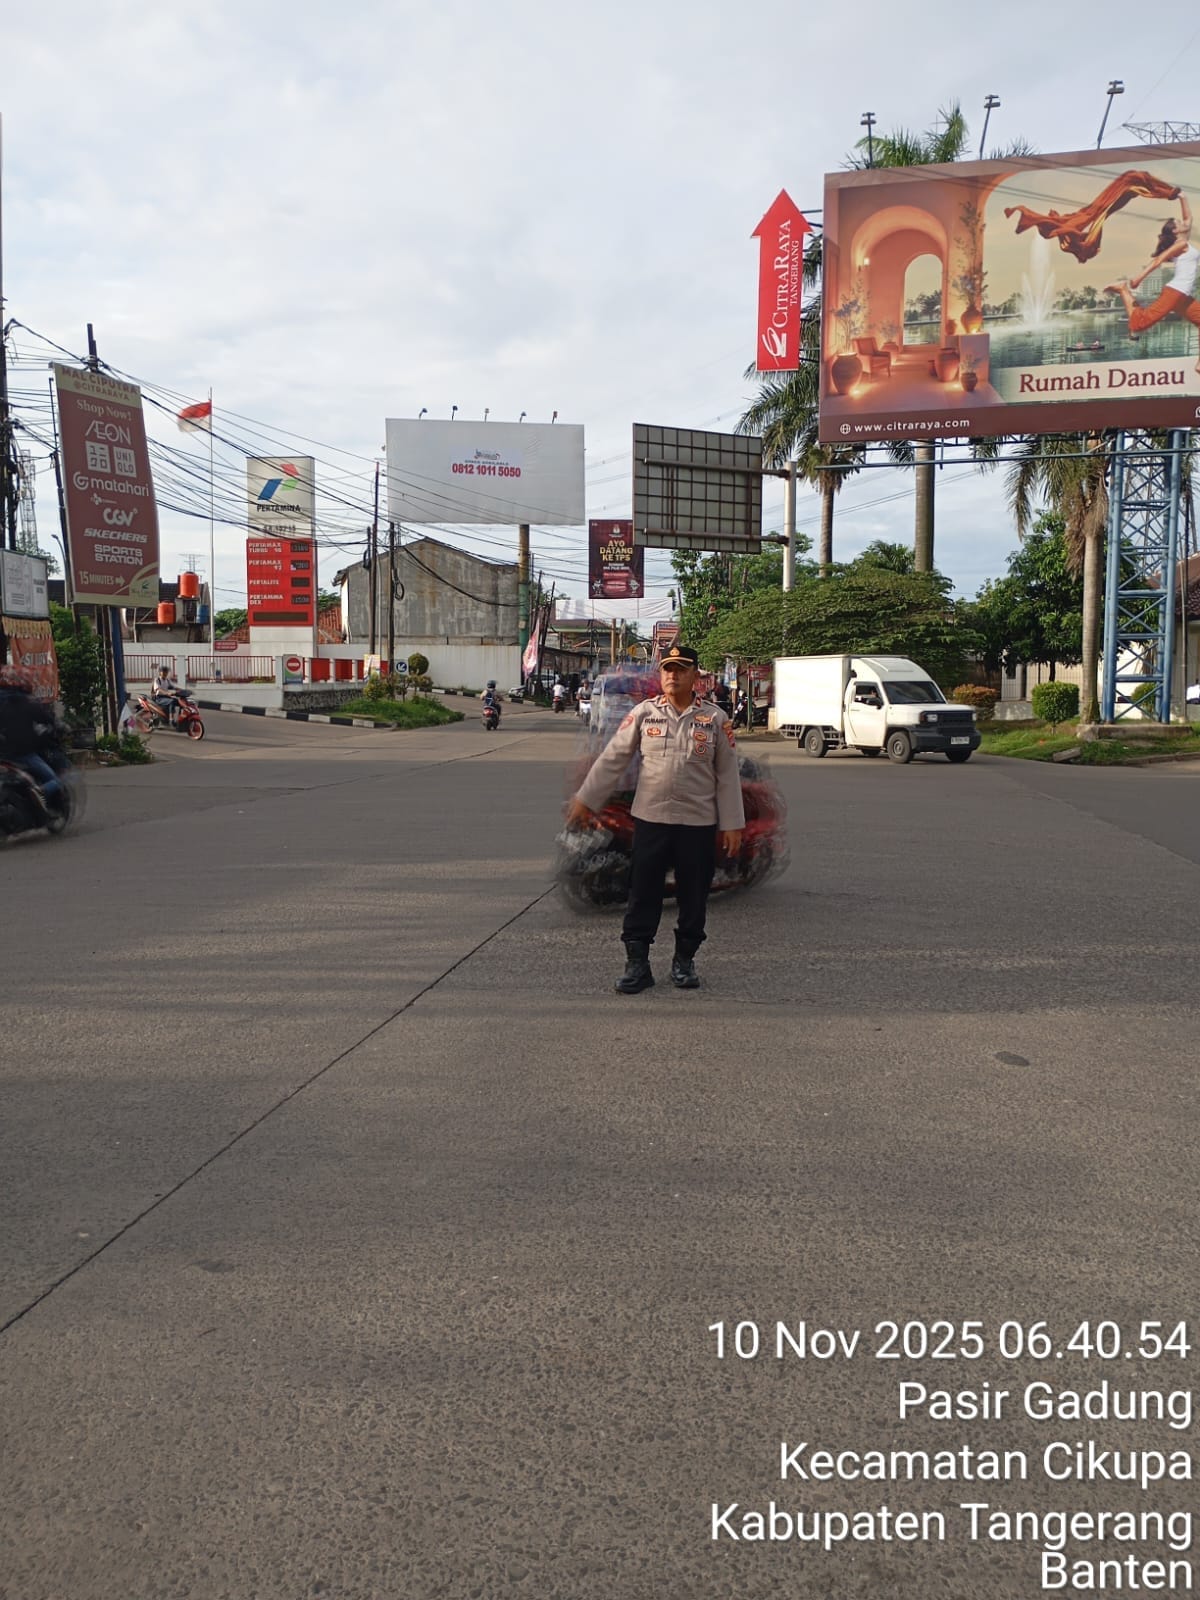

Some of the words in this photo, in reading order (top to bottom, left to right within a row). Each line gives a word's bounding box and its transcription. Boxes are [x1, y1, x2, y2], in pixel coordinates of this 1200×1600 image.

[789, 240, 799, 307] TANGERANG
[61, 367, 87, 381] MAL
[89, 374, 139, 394] CIPUTRA
[1019, 370, 1101, 394] Rumah
[1107, 366, 1186, 388] Danau
[76, 399, 104, 417] Shop
[105, 406, 132, 421] Now!
[854, 417, 971, 433] www.citraraya.com
[116, 450, 132, 463] UNI
[117, 462, 134, 475] QLO
[452, 463, 474, 475] 0812
[476, 464, 496, 476] 1011
[498, 466, 521, 477] 5050
[90, 478, 150, 497] matahari
[256, 504, 301, 513] PERTAMINA
[103, 507, 134, 527] CGV
[83, 528, 148, 543] SKECHERS
[607, 539, 625, 547] AYO
[94, 544, 143, 557] SPORTS
[599, 546, 633, 555] DATANG
[95, 553, 143, 566] STATION
[602, 554, 614, 562] KE
[615, 554, 631, 562] TPS
[79, 570, 89, 585] 15
[89, 573, 114, 585] MINUTES
